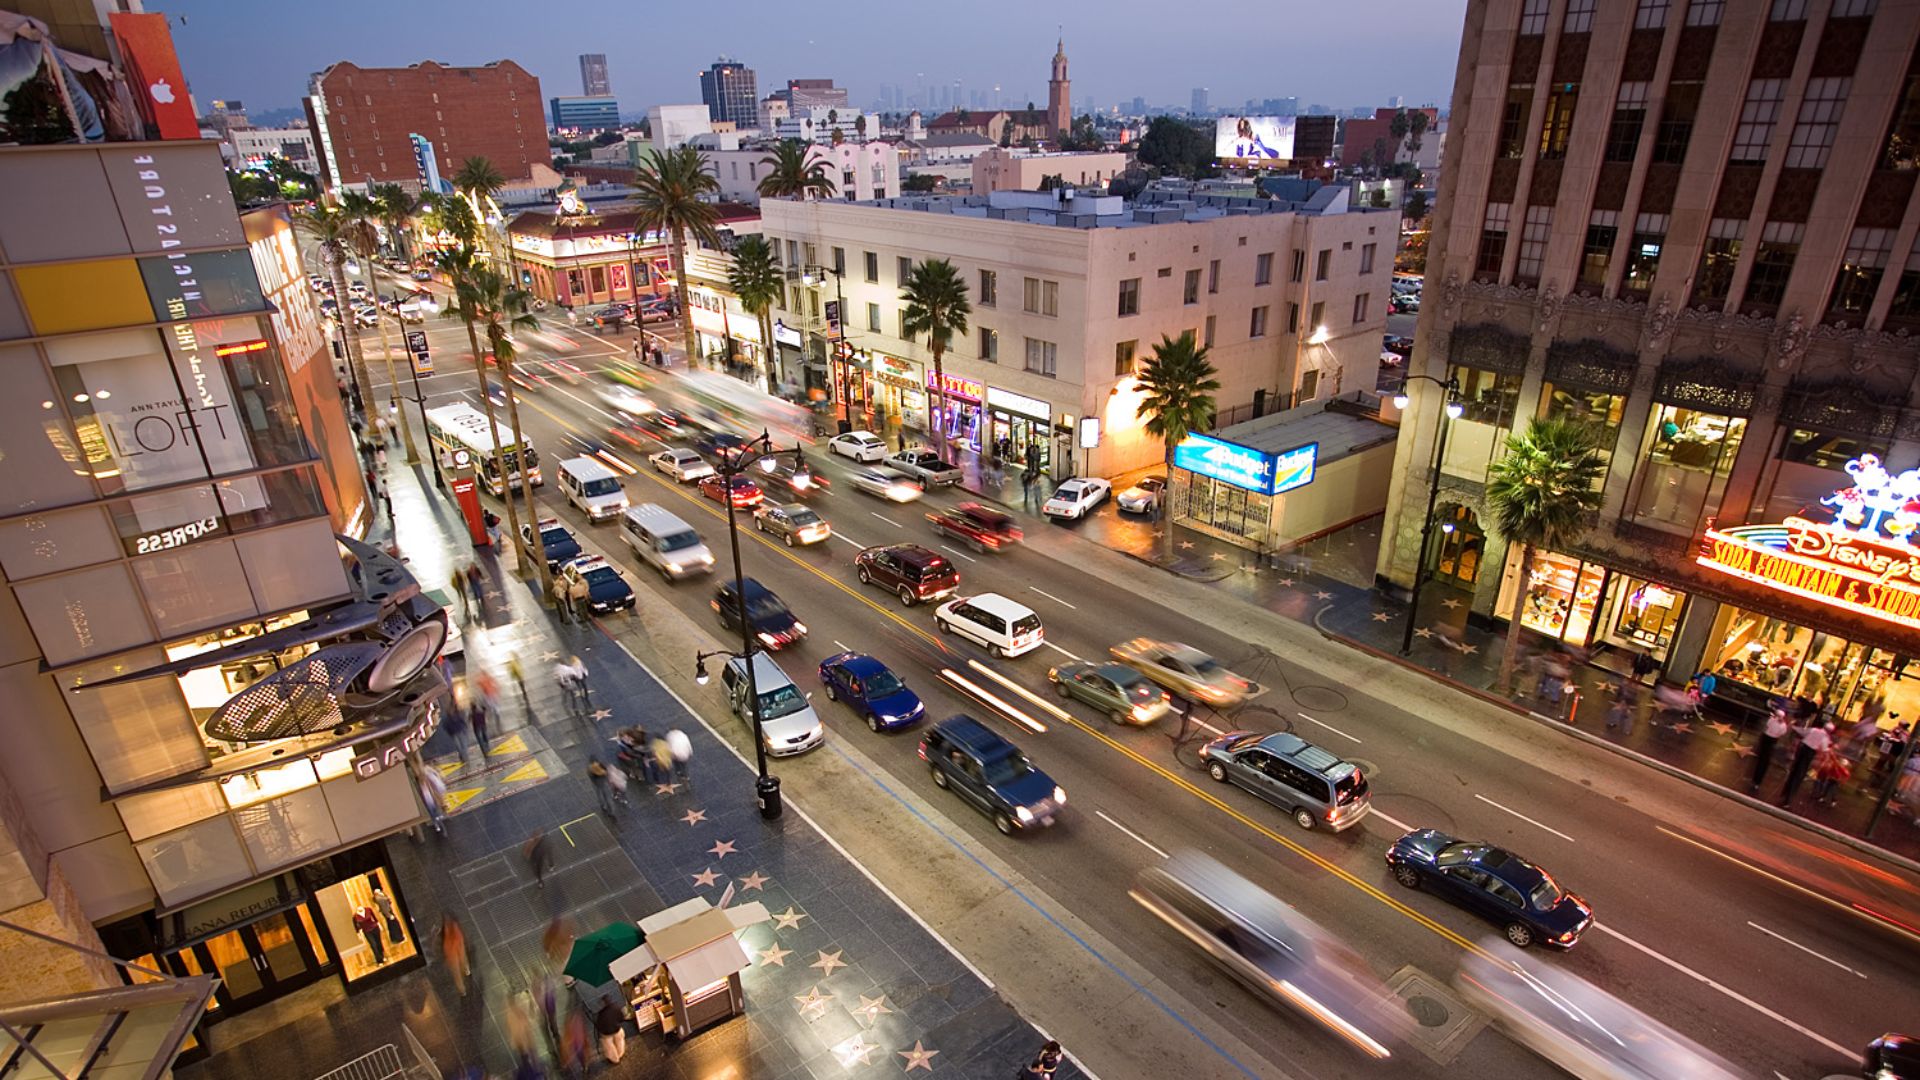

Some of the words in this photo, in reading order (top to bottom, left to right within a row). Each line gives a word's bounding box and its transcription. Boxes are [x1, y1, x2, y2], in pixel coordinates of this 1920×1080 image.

[107, 404, 228, 457] LOFT
[131, 402, 153, 413] ANN
[155, 397, 194, 409] TAYLOR
[1220, 446, 1271, 477] Budget
[1711, 540, 1752, 571] SODA
[1755, 553, 1843, 598] FOUNTAIN
[1844, 580, 1860, 602] &
[161, 916, 225, 947] ANANA
[230, 889, 301, 922] REPUBC
